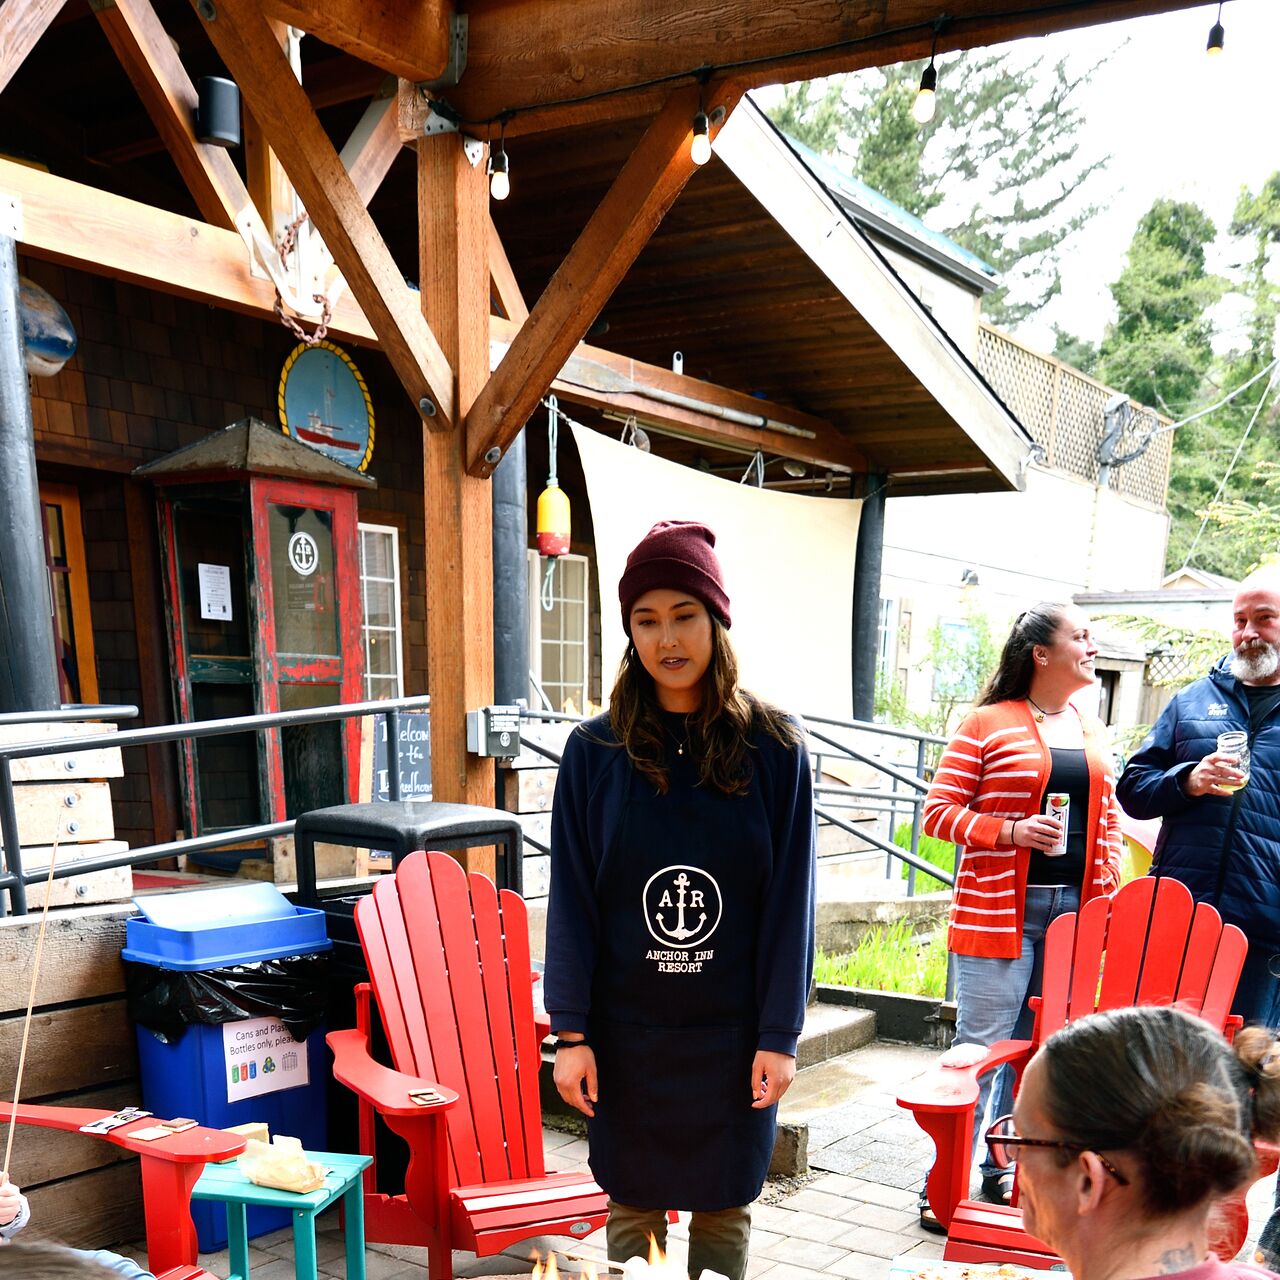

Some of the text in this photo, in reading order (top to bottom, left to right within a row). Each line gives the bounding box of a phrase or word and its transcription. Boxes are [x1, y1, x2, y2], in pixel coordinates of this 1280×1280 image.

[406, 744, 425, 765] the
[645, 949, 714, 961] ANCHOR INN
[657, 961, 703, 973] RESORT
[235, 1029, 254, 1041] Cans
[255, 1026, 269, 1037] and
[230, 1035, 295, 1056] Bottles only, pleas
